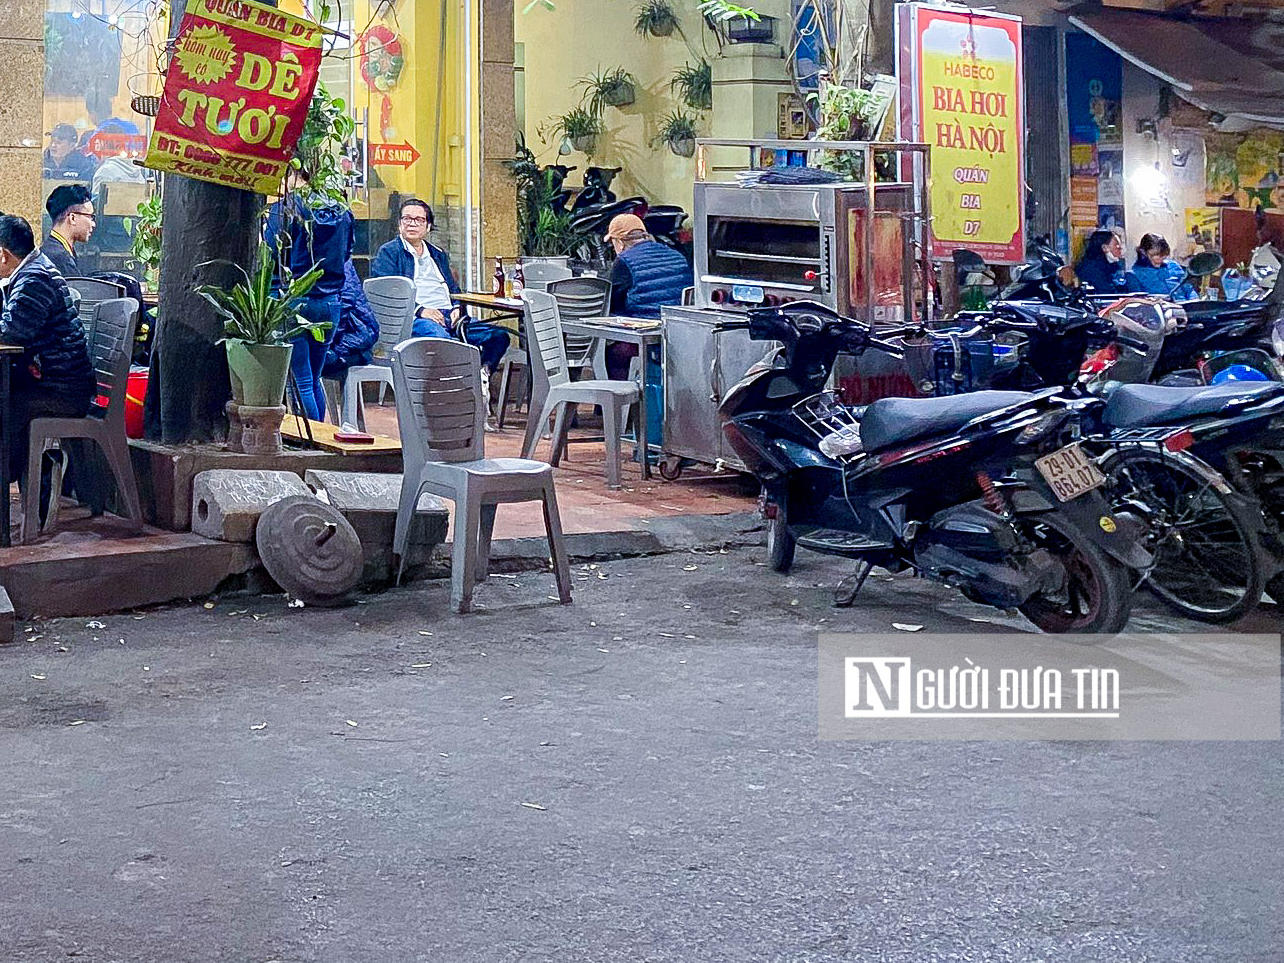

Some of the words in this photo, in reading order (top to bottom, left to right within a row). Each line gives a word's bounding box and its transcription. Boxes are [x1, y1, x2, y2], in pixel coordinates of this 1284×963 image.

[236, 51, 303, 101] DÊ
[944, 61, 995, 81] HABECO
[932, 86, 968, 114] BIA
[177, 88, 292, 151] TƯƠI
[935, 117, 967, 150] HÀ
[968, 121, 1006, 159] NỘI
[953, 164, 989, 184] QUÁN
[960, 194, 981, 209] BIA
[964, 220, 981, 237] D7
